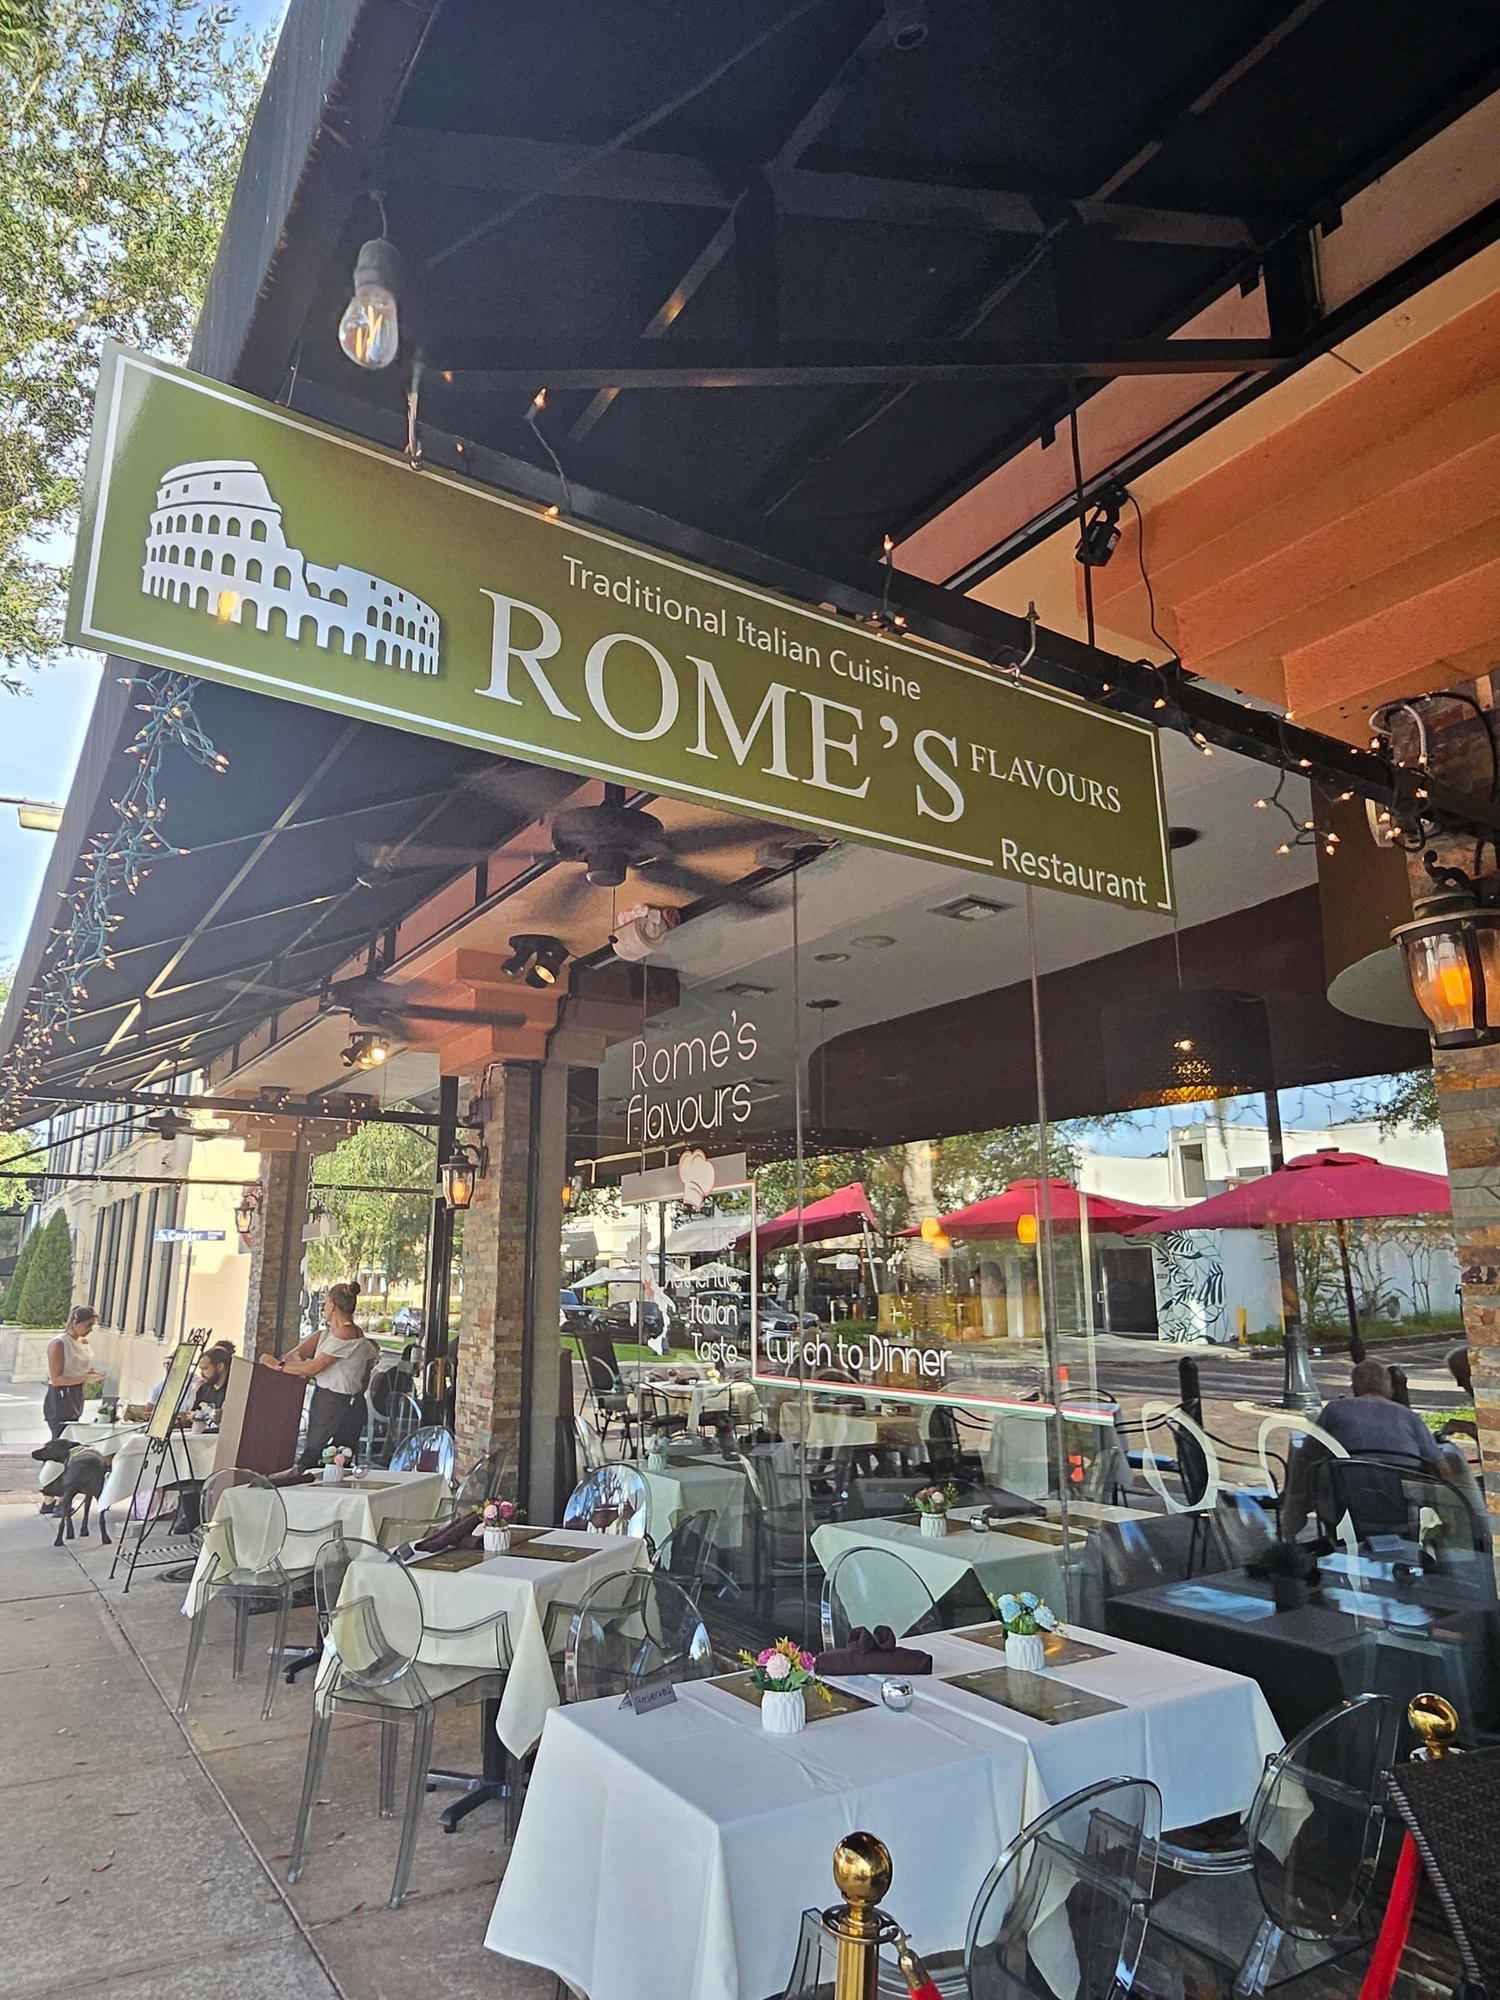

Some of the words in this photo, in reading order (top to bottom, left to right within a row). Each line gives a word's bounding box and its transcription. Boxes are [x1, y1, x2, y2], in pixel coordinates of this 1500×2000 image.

[562, 555, 727, 637] Traditional
[736, 618, 821, 669] Italian
[829, 650, 922, 702] Cuisine
[968, 742, 1122, 815] FLAVOURS
[1000, 837, 1149, 904] Restaurant
[631, 1009, 757, 1091] Rome's
[689, 1295, 739, 1326] Italian
[691, 1331, 738, 1365] Taste
[837, 1334, 864, 1370] to
[869, 1334, 953, 1378] Dinner
